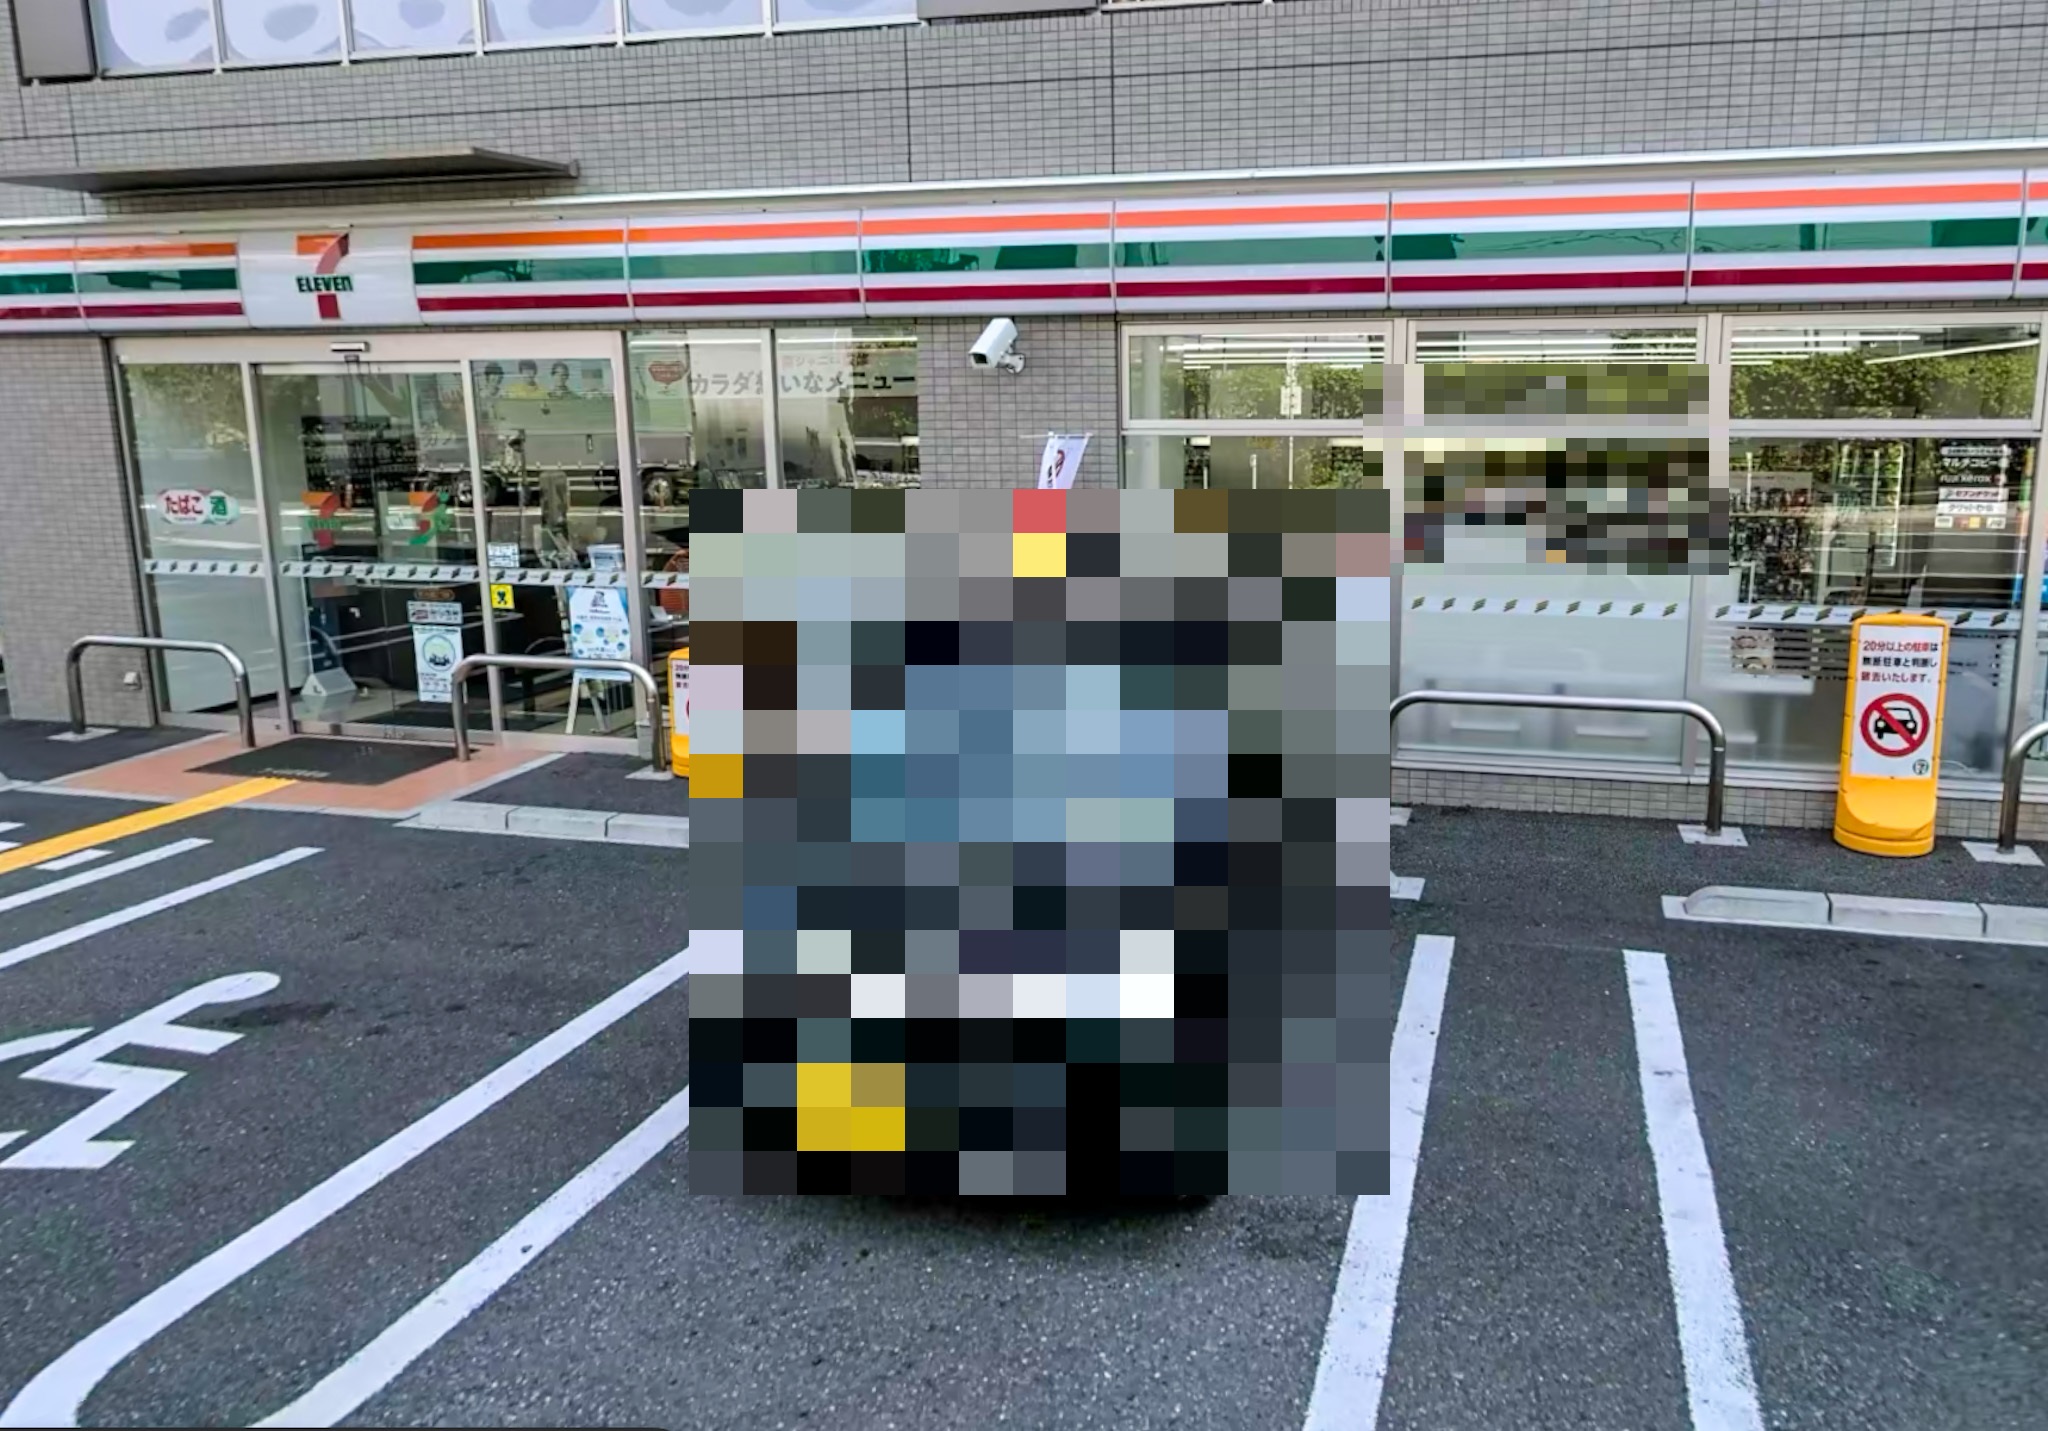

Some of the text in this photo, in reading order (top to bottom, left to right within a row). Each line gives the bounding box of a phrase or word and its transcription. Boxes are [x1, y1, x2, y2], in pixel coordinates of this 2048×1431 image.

[296, 232, 349, 319] 7
[692, 370, 916, 395] カラダいなメニュー
[165, 495, 203, 514] たばこ
[1863, 640, 1938, 653] 20分以上の駐車は
[1862, 656, 1938, 668] 無断駐車と判断し
